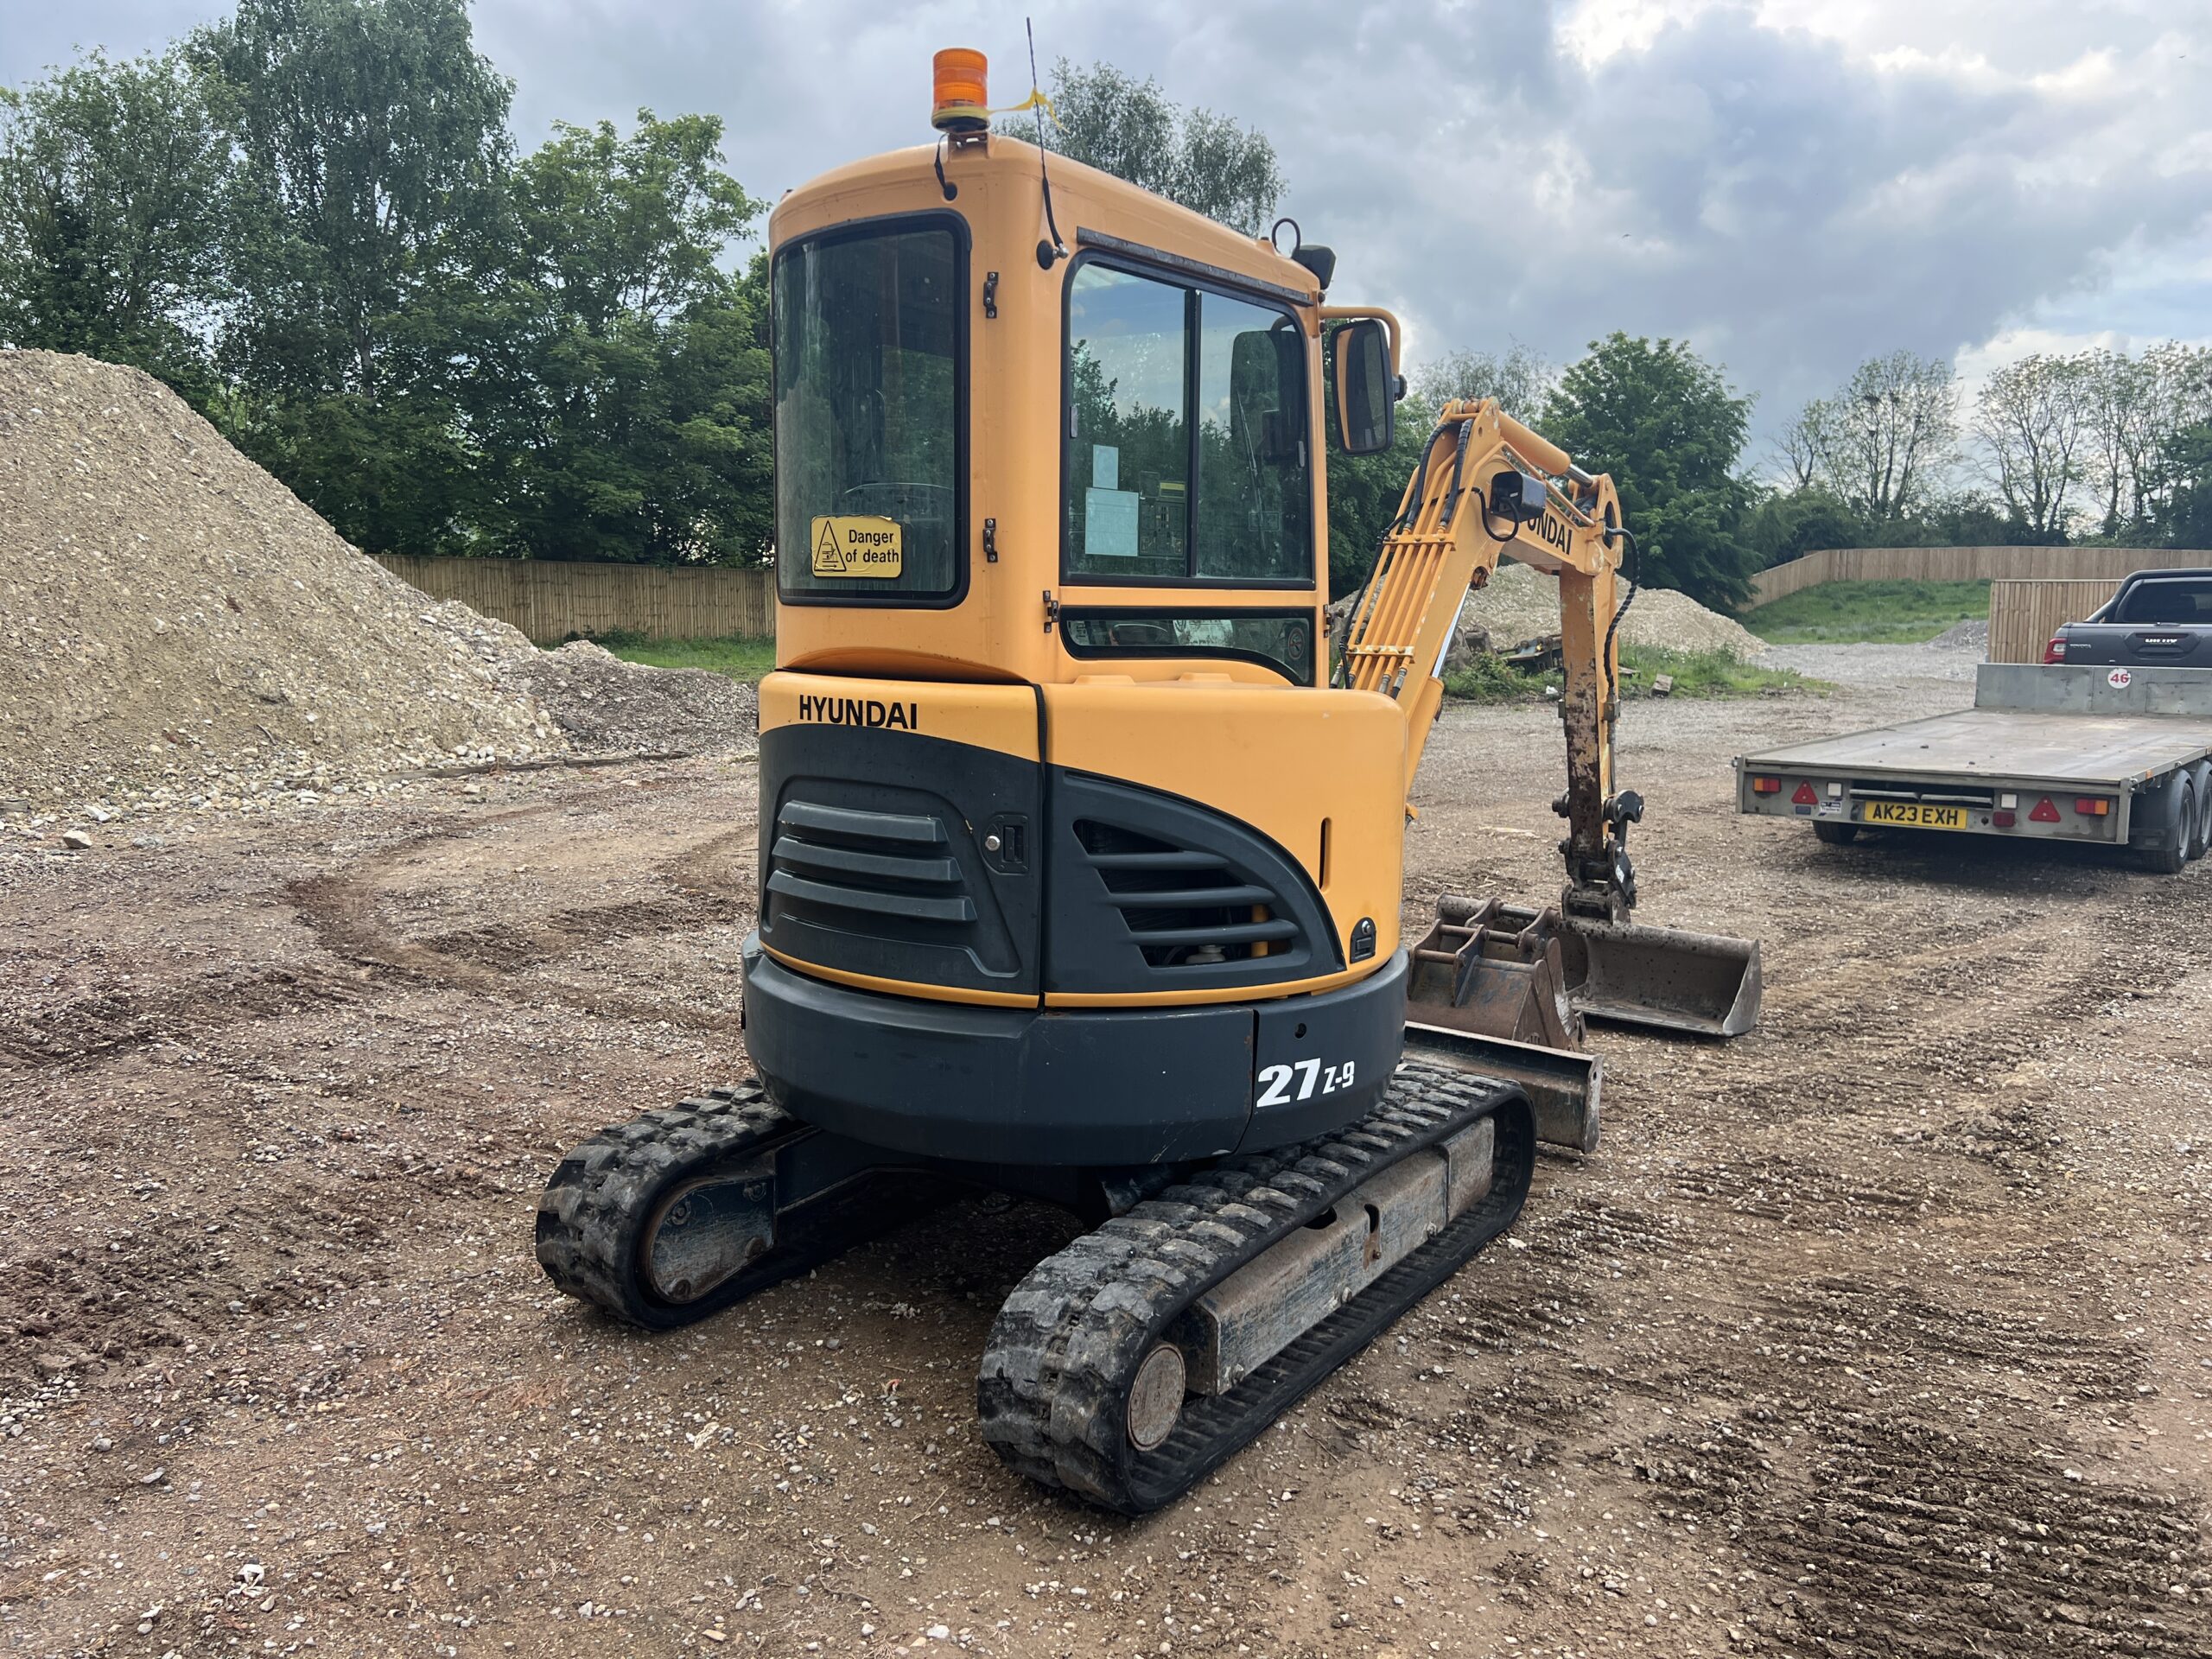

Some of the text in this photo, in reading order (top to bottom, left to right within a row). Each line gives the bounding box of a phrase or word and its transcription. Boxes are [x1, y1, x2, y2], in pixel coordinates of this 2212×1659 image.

[849, 529, 894, 546] Danger
[1527, 513, 1573, 556] UNDAI
[845, 549, 899, 563] of death
[2109, 673, 2130, 684] 46
[799, 694, 918, 730] HYUNDAI
[1872, 804, 1959, 826] AK23 EXH
[1256, 1058, 1321, 1108] 27
